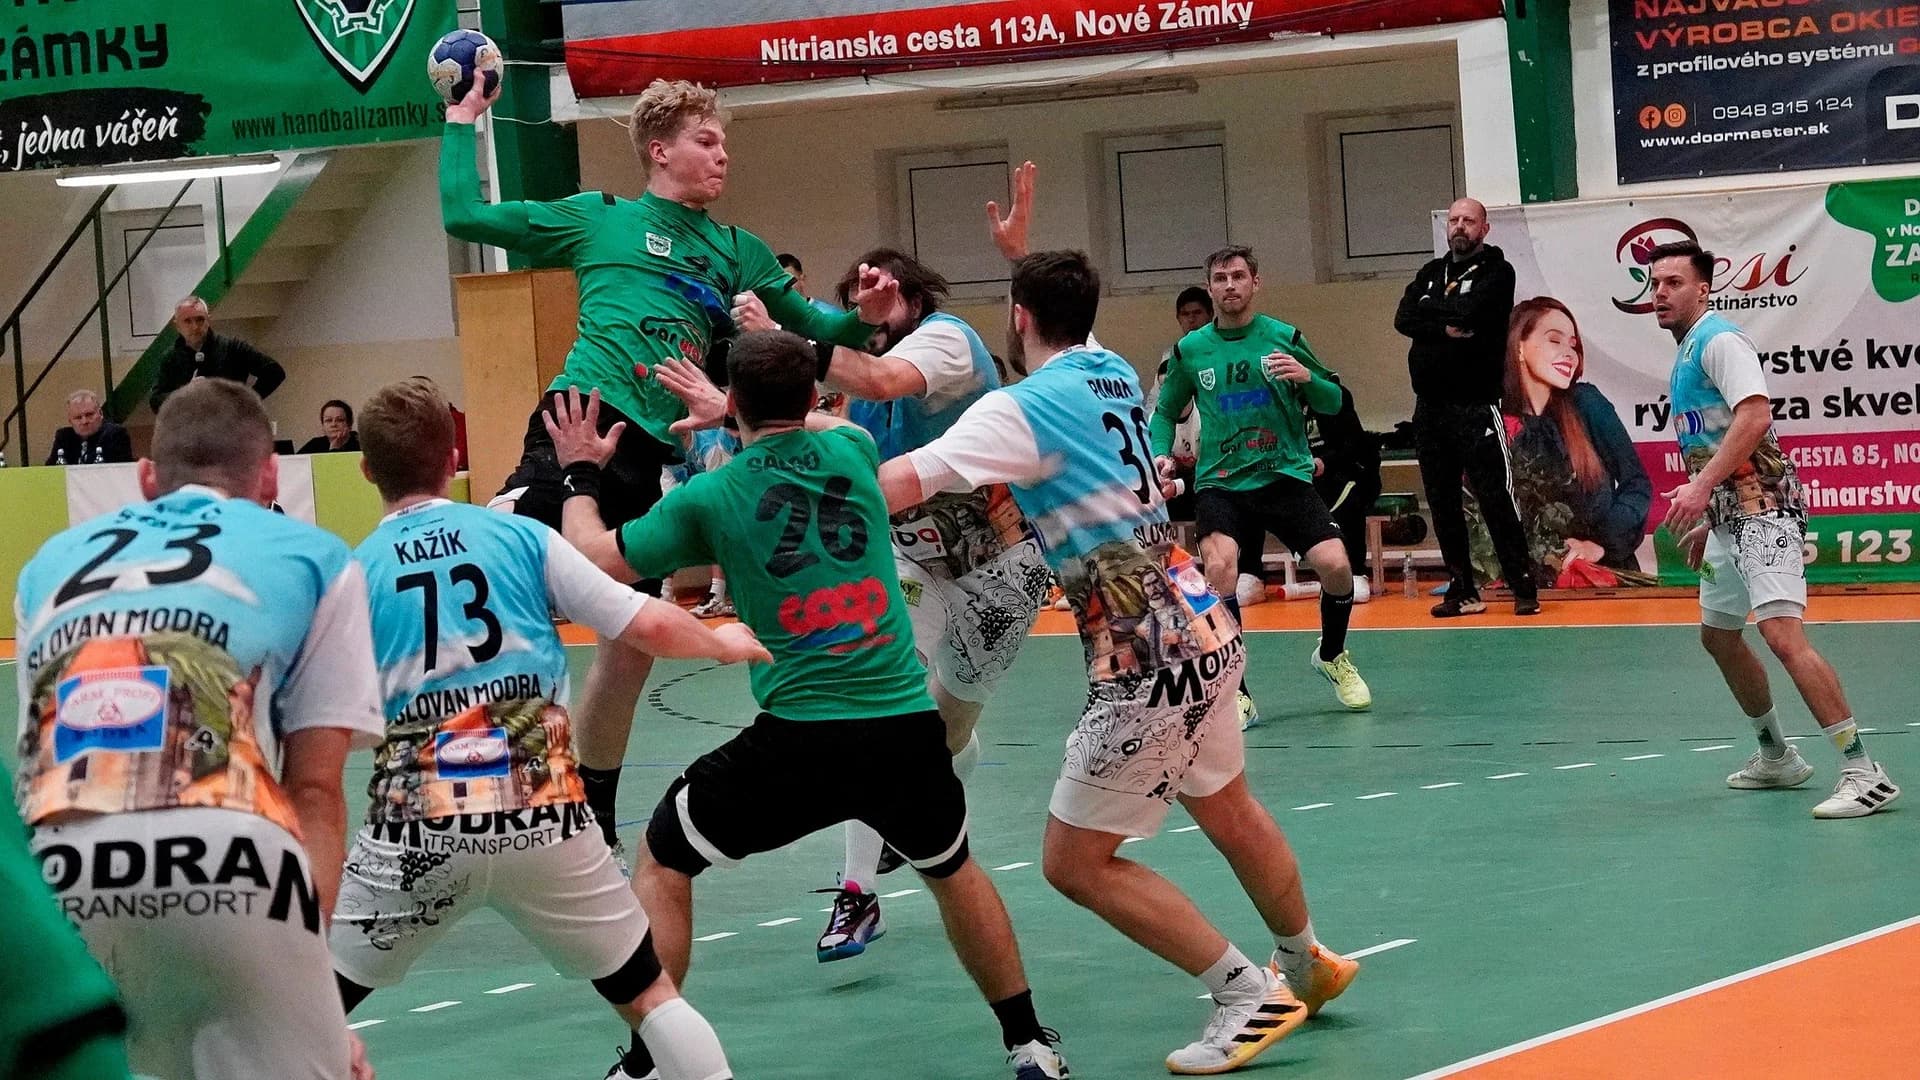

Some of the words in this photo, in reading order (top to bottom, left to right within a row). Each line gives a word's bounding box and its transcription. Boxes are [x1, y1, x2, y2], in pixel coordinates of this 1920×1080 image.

[760, 30, 898, 64] Nitrianska
[907, 22, 981, 52] cesta
[990, 14, 1065, 44] 113A,
[1075, 3, 1150, 37] Nové
[1158, 0, 1253, 30] Zámky
[1635, 16, 1820, 50] VÝROBCA
[1830, 5, 1920, 34] OKIE
[0, 24, 168, 81] ÁMKY
[1637, 64, 1649, 77] z
[1653, 51, 1784, 79] profilového
[1787, 43, 1894, 67] systému
[1898, 37, 1920, 54] G
[231, 102, 446, 140] www.handballzamky.s
[1713, 104, 1767, 120] 0948
[1771, 99, 1809, 115] 315
[1816, 97, 1854, 111] 124
[12, 115, 85, 171] jedna
[96, 106, 178, 147] vášeň
[1640, 122, 1830, 149] www.doormaster.sk
[1886, 227, 1896, 237] v
[1707, 293, 1798, 312] etinárstvo
[1226, 359, 1250, 385] 18
[1757, 338, 1853, 374] rstvé
[1635, 395, 1671, 432] rý
[1770, 397, 1810, 421] za
[1790, 446, 1848, 468] CESTA
[1852, 444, 1889, 469] 85,
[1801, 480, 1920, 507] tinarstvo
[393, 527, 468, 565] KAŽÍK
[755, 476, 869, 579] 26
[1801, 532, 1819, 565] 5
[1837, 530, 1913, 563] 123
[54, 524, 222, 609] 23
[395, 562, 502, 674] 73
[28, 611, 117, 671] SLOVAN
[125, 607, 231, 651] MODRA
[394, 687, 471, 727] SLOVAN
[473, 673, 543, 705] MODRA
[428, 828, 555, 855] TRANSPORT
[60, 888, 258, 921] RANSPORT
